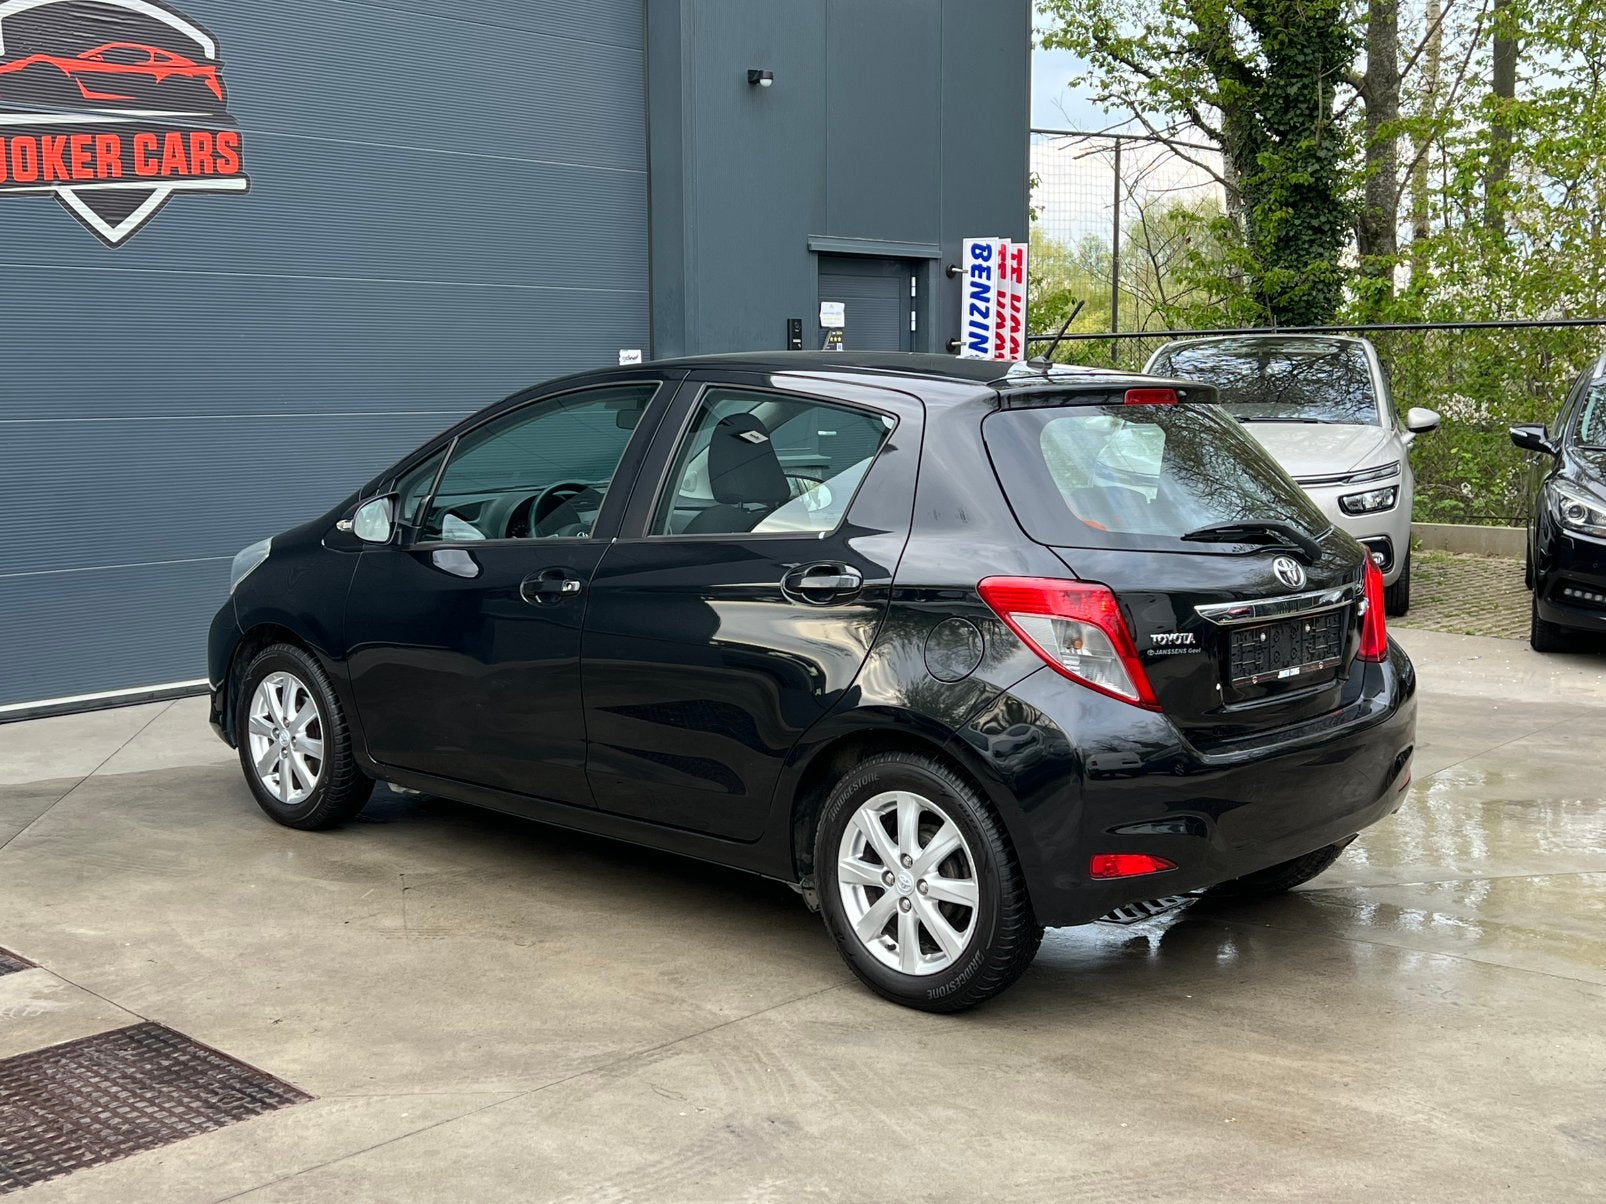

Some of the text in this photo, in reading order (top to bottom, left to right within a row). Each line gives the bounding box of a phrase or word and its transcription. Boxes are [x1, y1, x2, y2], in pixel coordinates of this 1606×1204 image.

[134, 131, 240, 176] CARS
[968, 242, 993, 354] BENZIN
[1150, 632, 1196, 646] TOYOTA
[1154, 647, 1187, 656] JANSSENS
